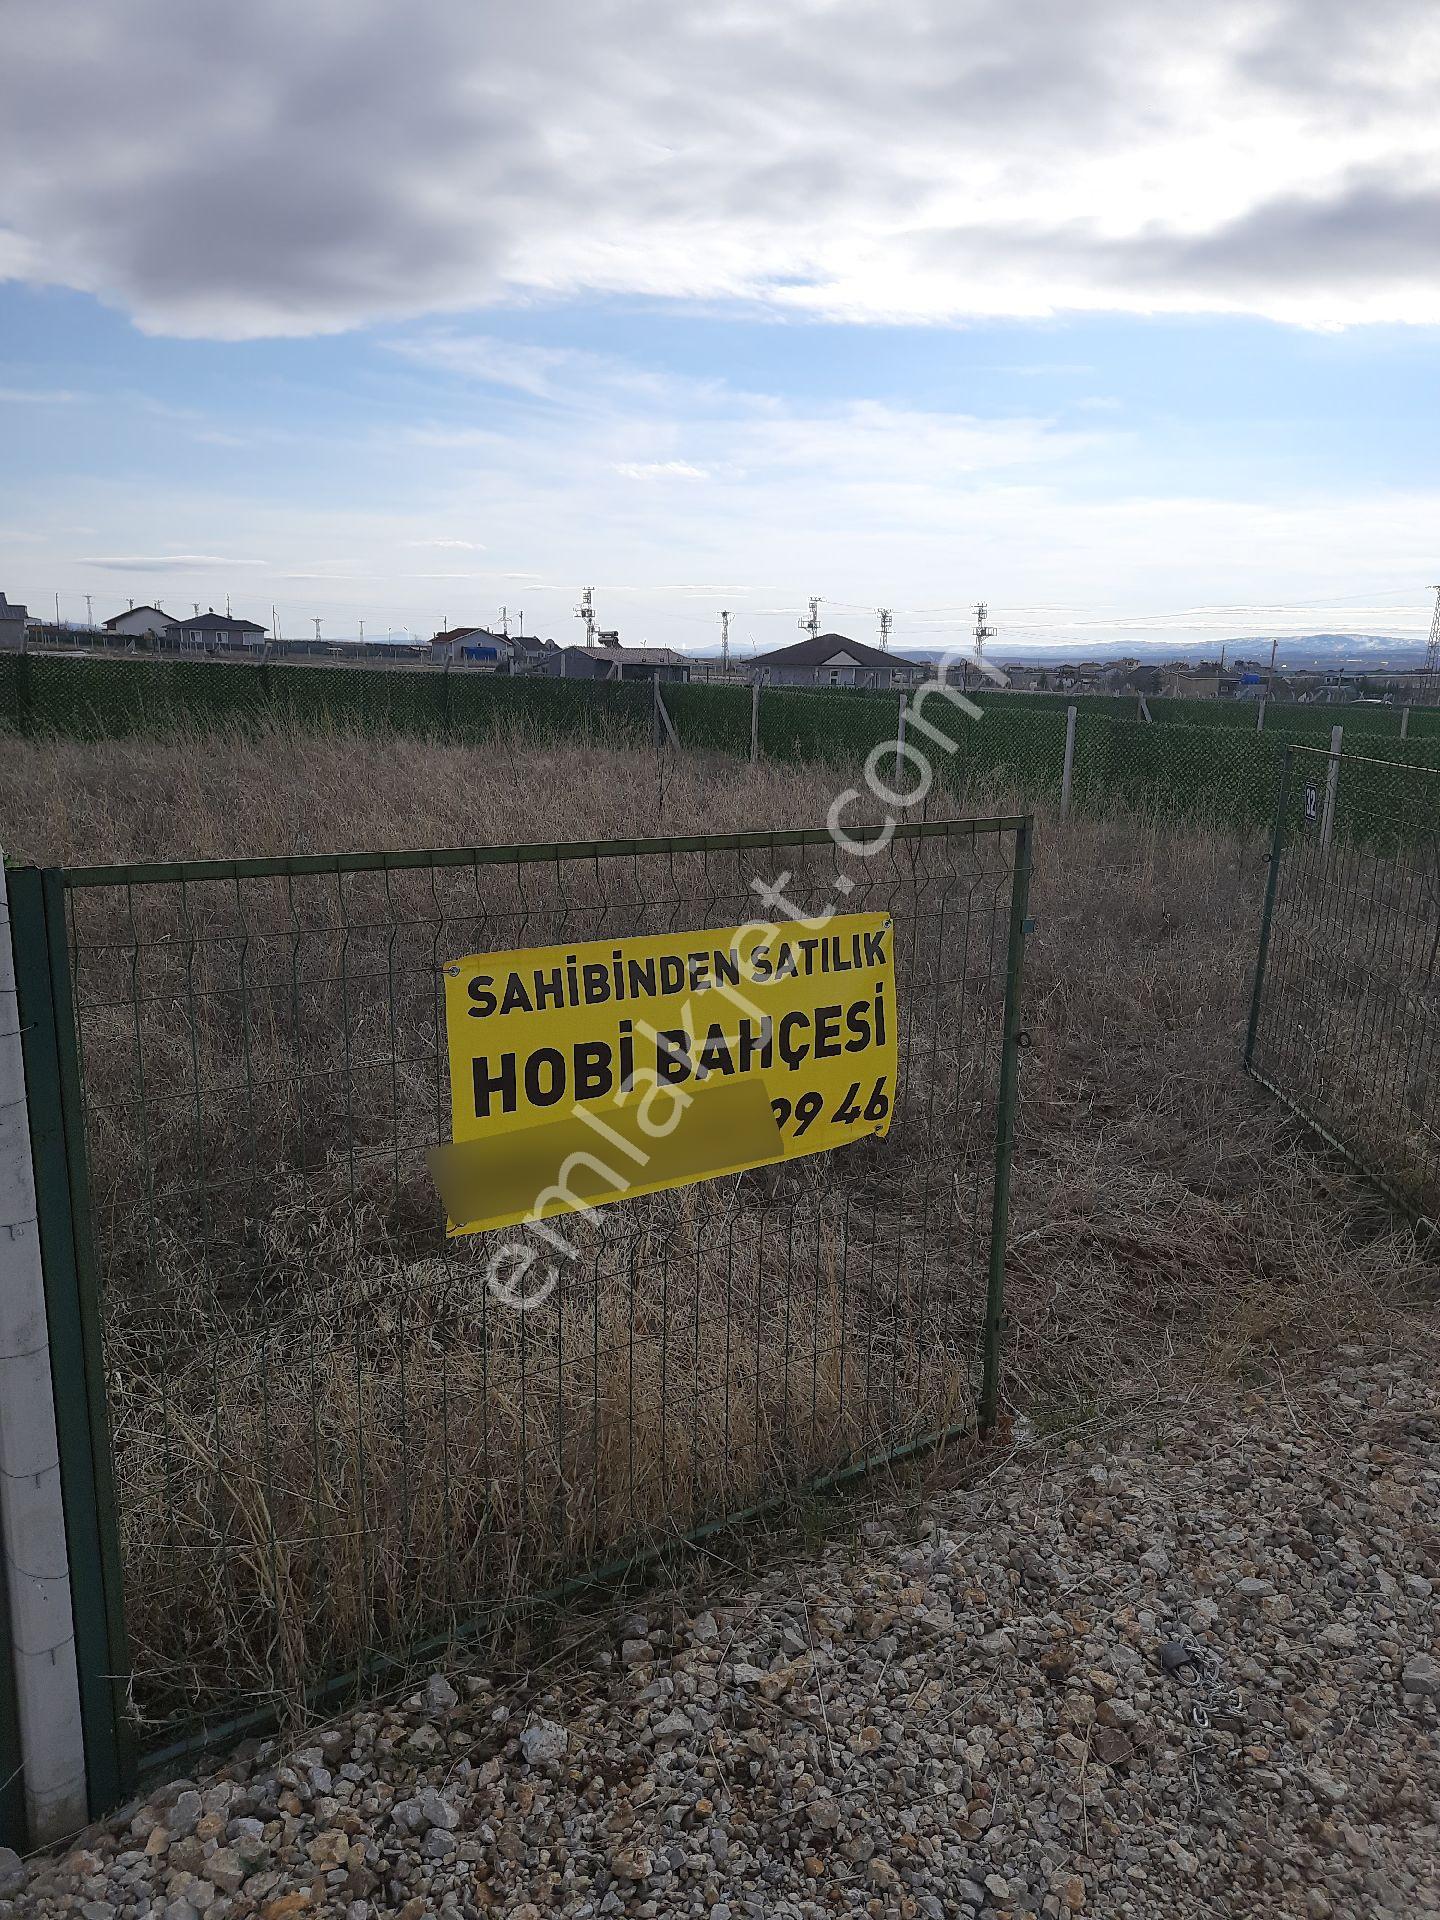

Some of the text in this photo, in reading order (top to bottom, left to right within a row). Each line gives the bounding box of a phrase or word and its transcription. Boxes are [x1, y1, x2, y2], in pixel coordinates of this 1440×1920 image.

[1306, 788, 1316, 816] 32
[467, 930, 887, 1018] SAHİBİNDEN SATILIK
[471, 981, 887, 1118] HOBİ BAHÇESİ
[831, 1076, 889, 1125] 46
